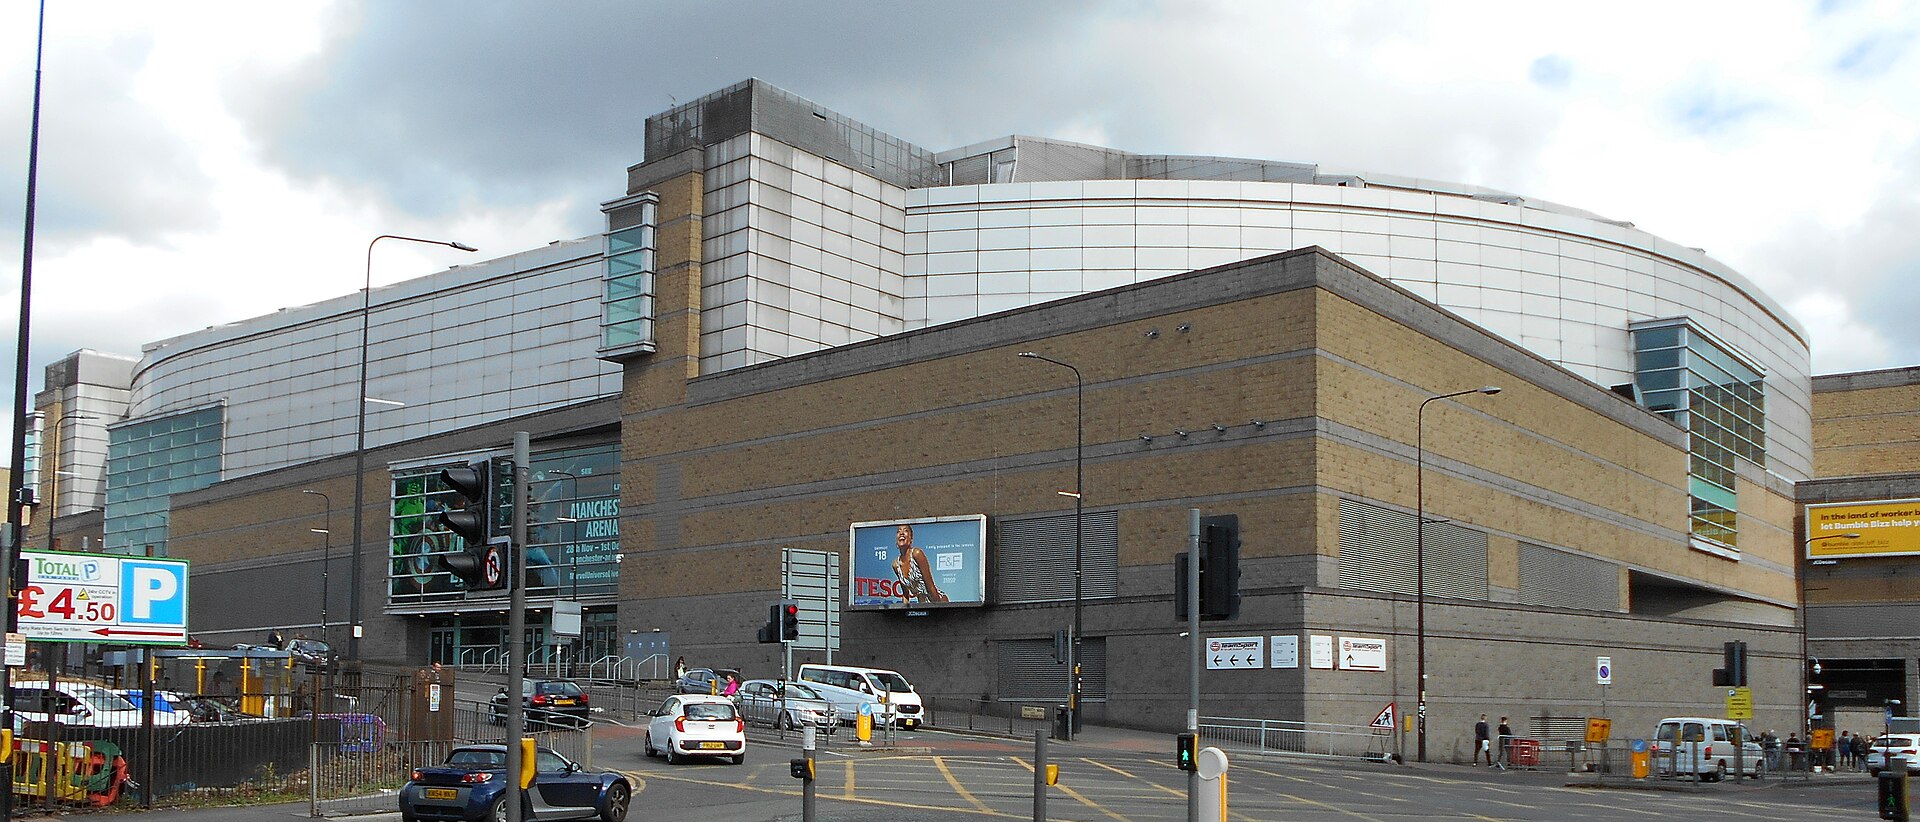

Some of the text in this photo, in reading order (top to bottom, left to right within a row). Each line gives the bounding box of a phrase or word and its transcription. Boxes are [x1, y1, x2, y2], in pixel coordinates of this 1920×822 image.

[570, 498, 620, 519] MANCHES
[1848, 511, 1868, 519] land
[1870, 510, 1880, 518] of
[1880, 509, 1913, 517] worker
[586, 520, 619, 537] ARENA
[1834, 521, 1869, 529] Bumble
[1870, 520, 1890, 528] Bizz
[1891, 519, 1912, 527] help
[939, 555, 960, 567] F&F
[132, 567, 178, 619] P
[854, 578, 918, 599] TESC
